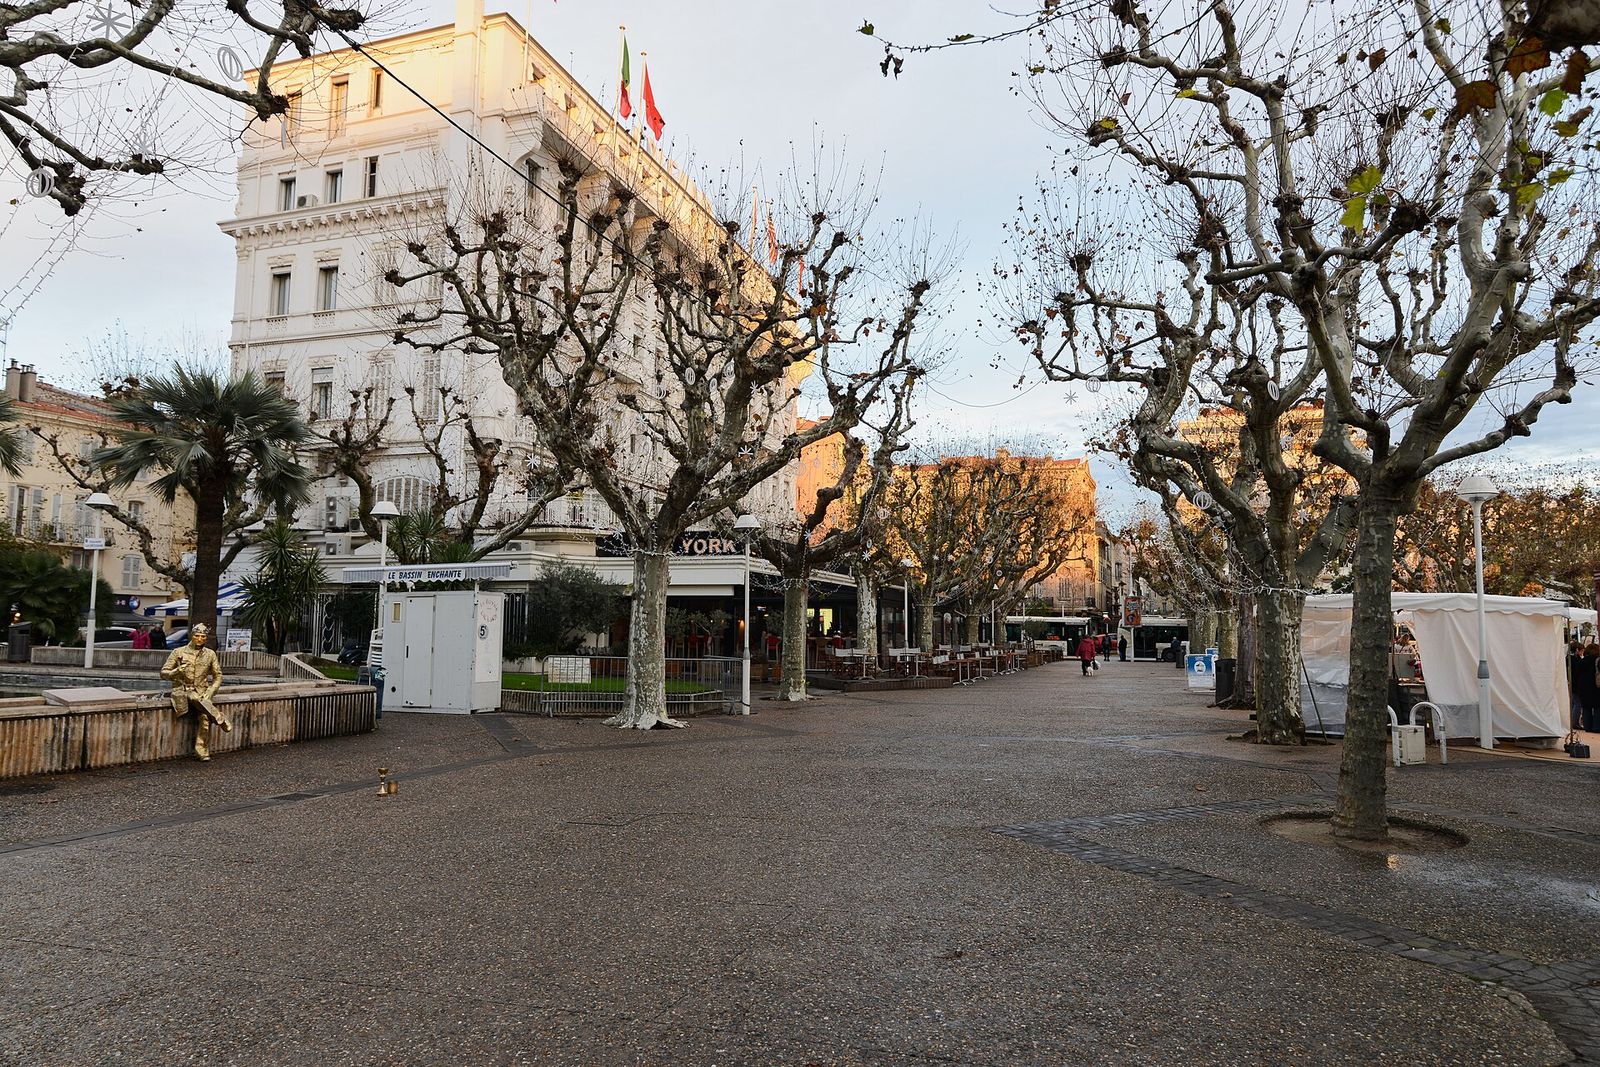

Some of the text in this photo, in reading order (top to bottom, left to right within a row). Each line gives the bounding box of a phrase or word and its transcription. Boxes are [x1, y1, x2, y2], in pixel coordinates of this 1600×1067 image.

[682, 538, 736, 554] YORK
[398, 571, 423, 579] BASSIN
[427, 570, 462, 579] ENCHANTE
